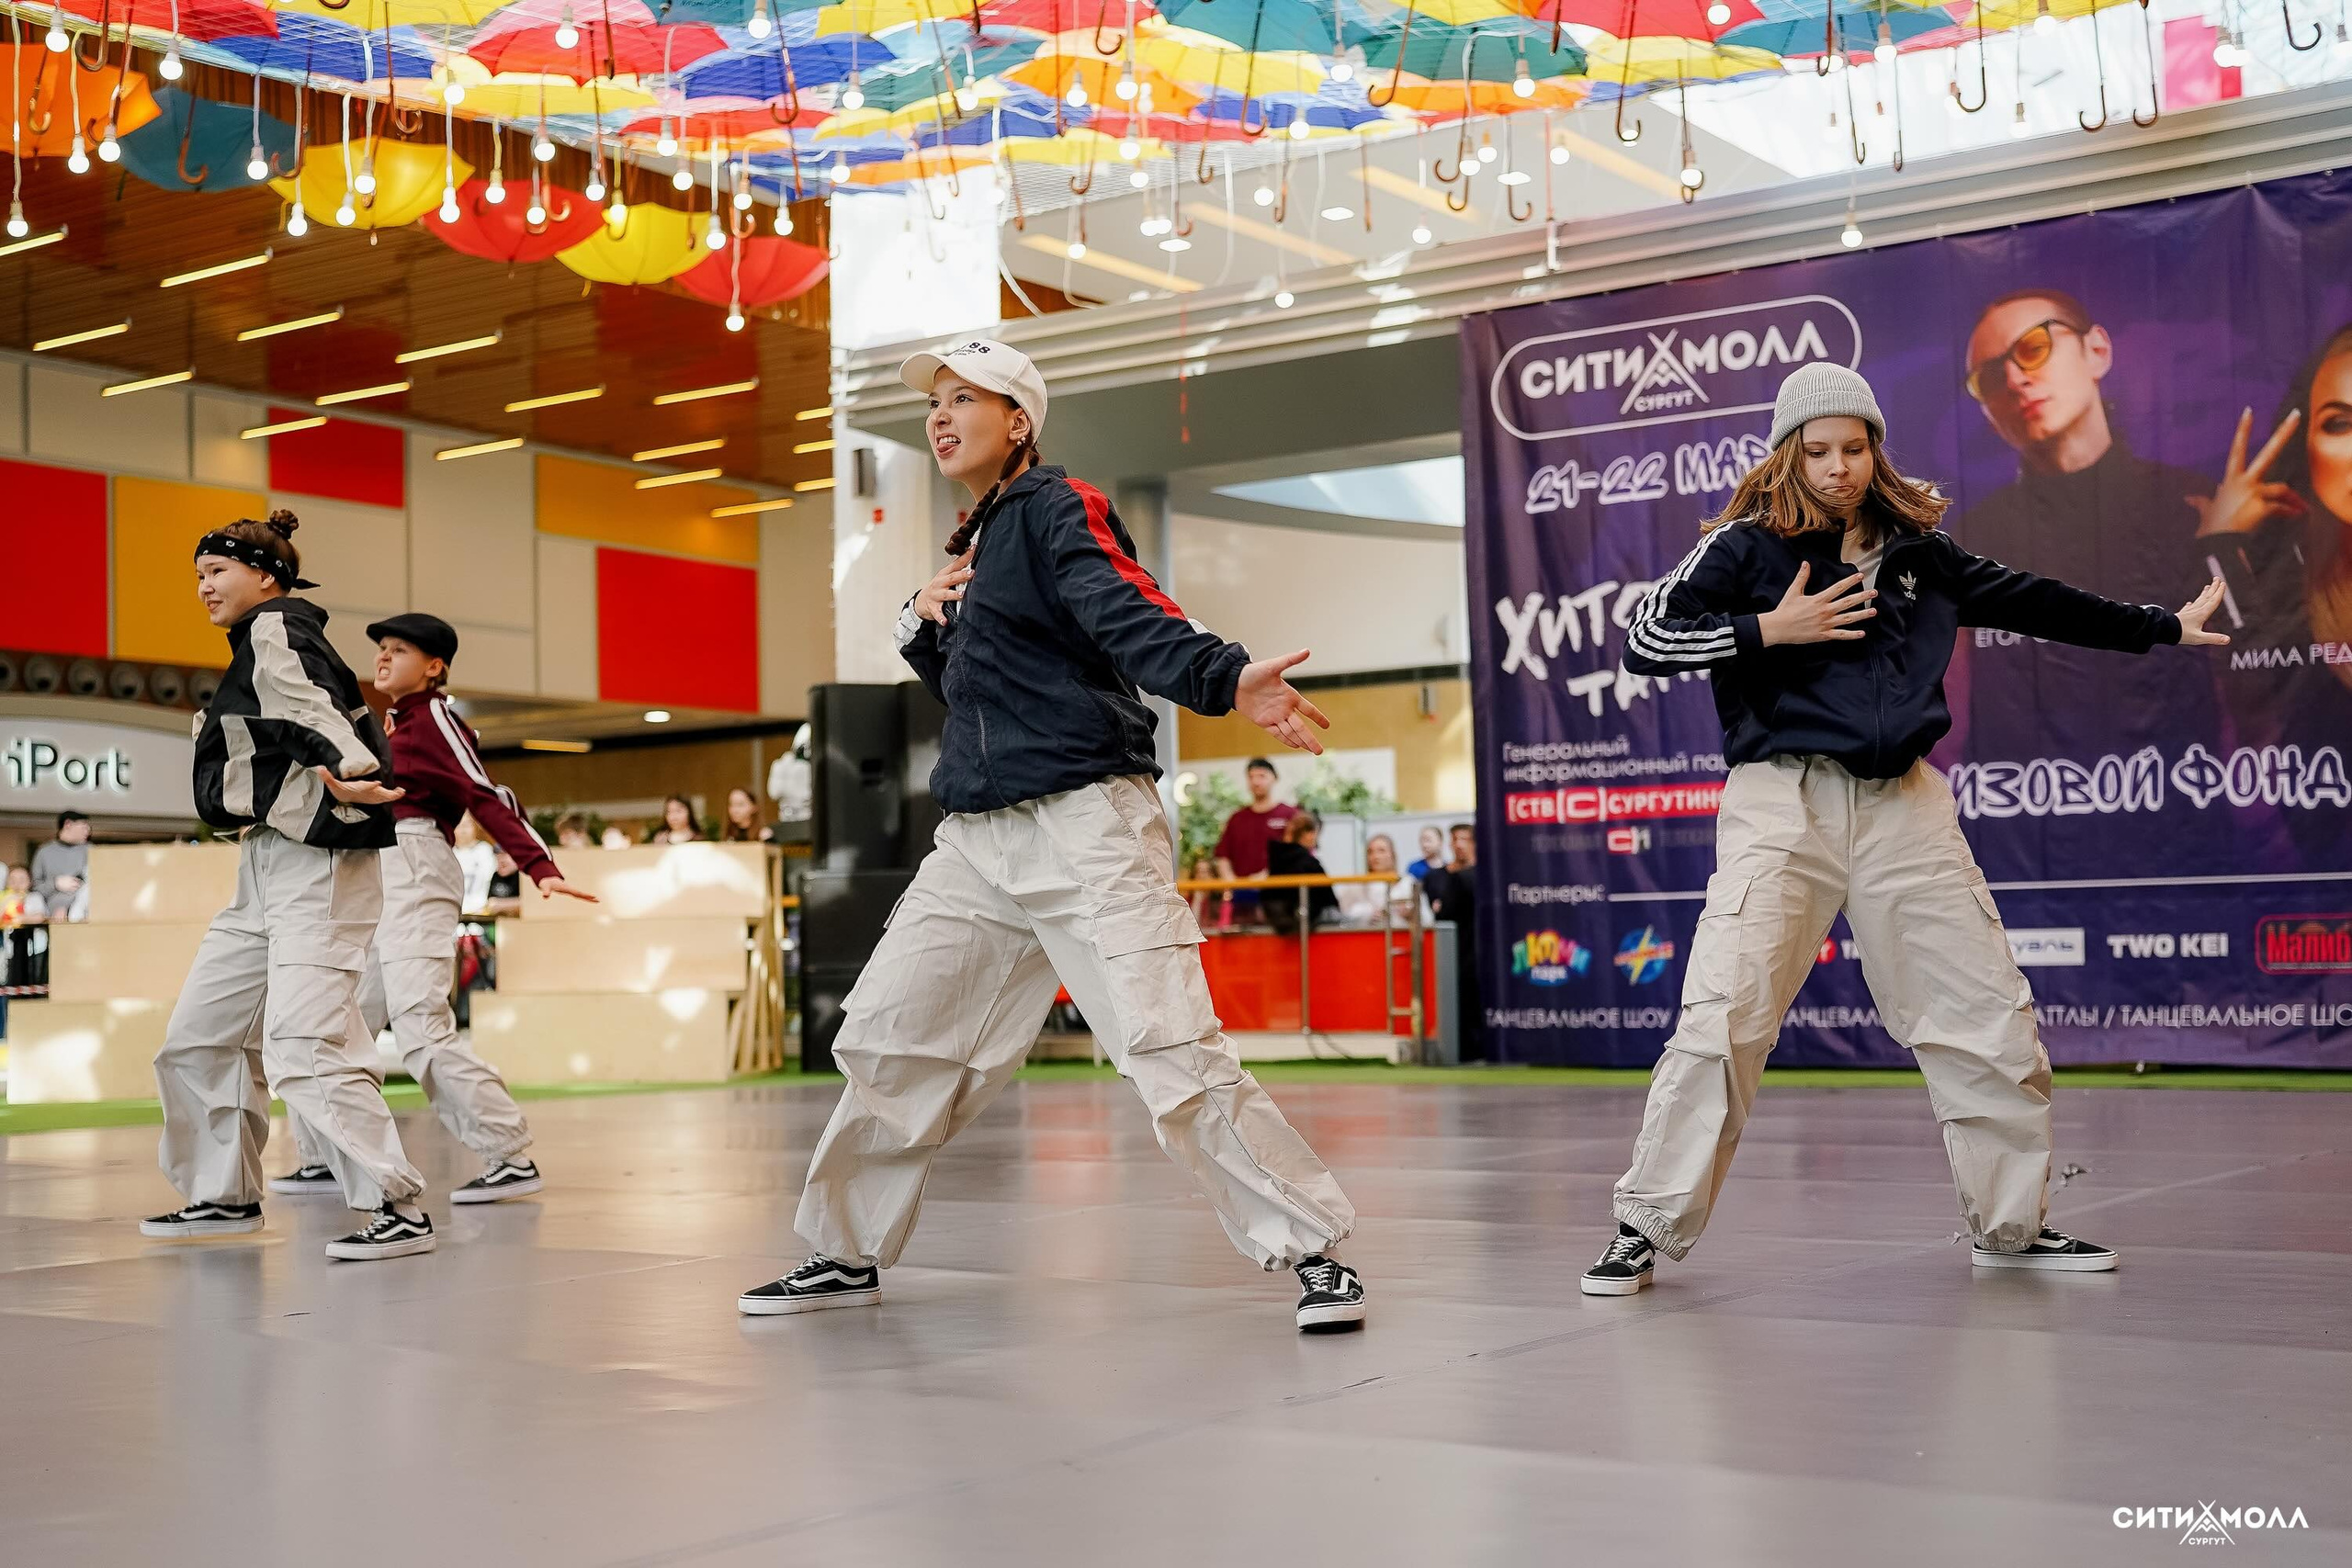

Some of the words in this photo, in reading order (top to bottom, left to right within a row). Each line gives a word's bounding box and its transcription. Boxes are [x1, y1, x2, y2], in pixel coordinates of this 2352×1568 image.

[1520, 344, 1646, 400] СИТИ
[1681, 320, 1828, 375] МОЛЛ
[1524, 451, 1670, 514] 21-22
[1674, 433, 1773, 496] МАР
[1495, 571, 1670, 680] ХИТО
[2230, 645, 2304, 671] МИЛА
[1945, 744, 2165, 819] ИЗОВОЙ
[2170, 742, 2352, 810] ФОНД
[2107, 934, 2176, 958] TWO
[2181, 932, 2229, 958] KEI
[1781, 1006, 1885, 1028] АНЦЕВАЛ
[2033, 1005, 2100, 1027] АТТЛЫ
[2120, 1003, 2304, 1029] ТАНЦЕВАЛЬНОЕ
